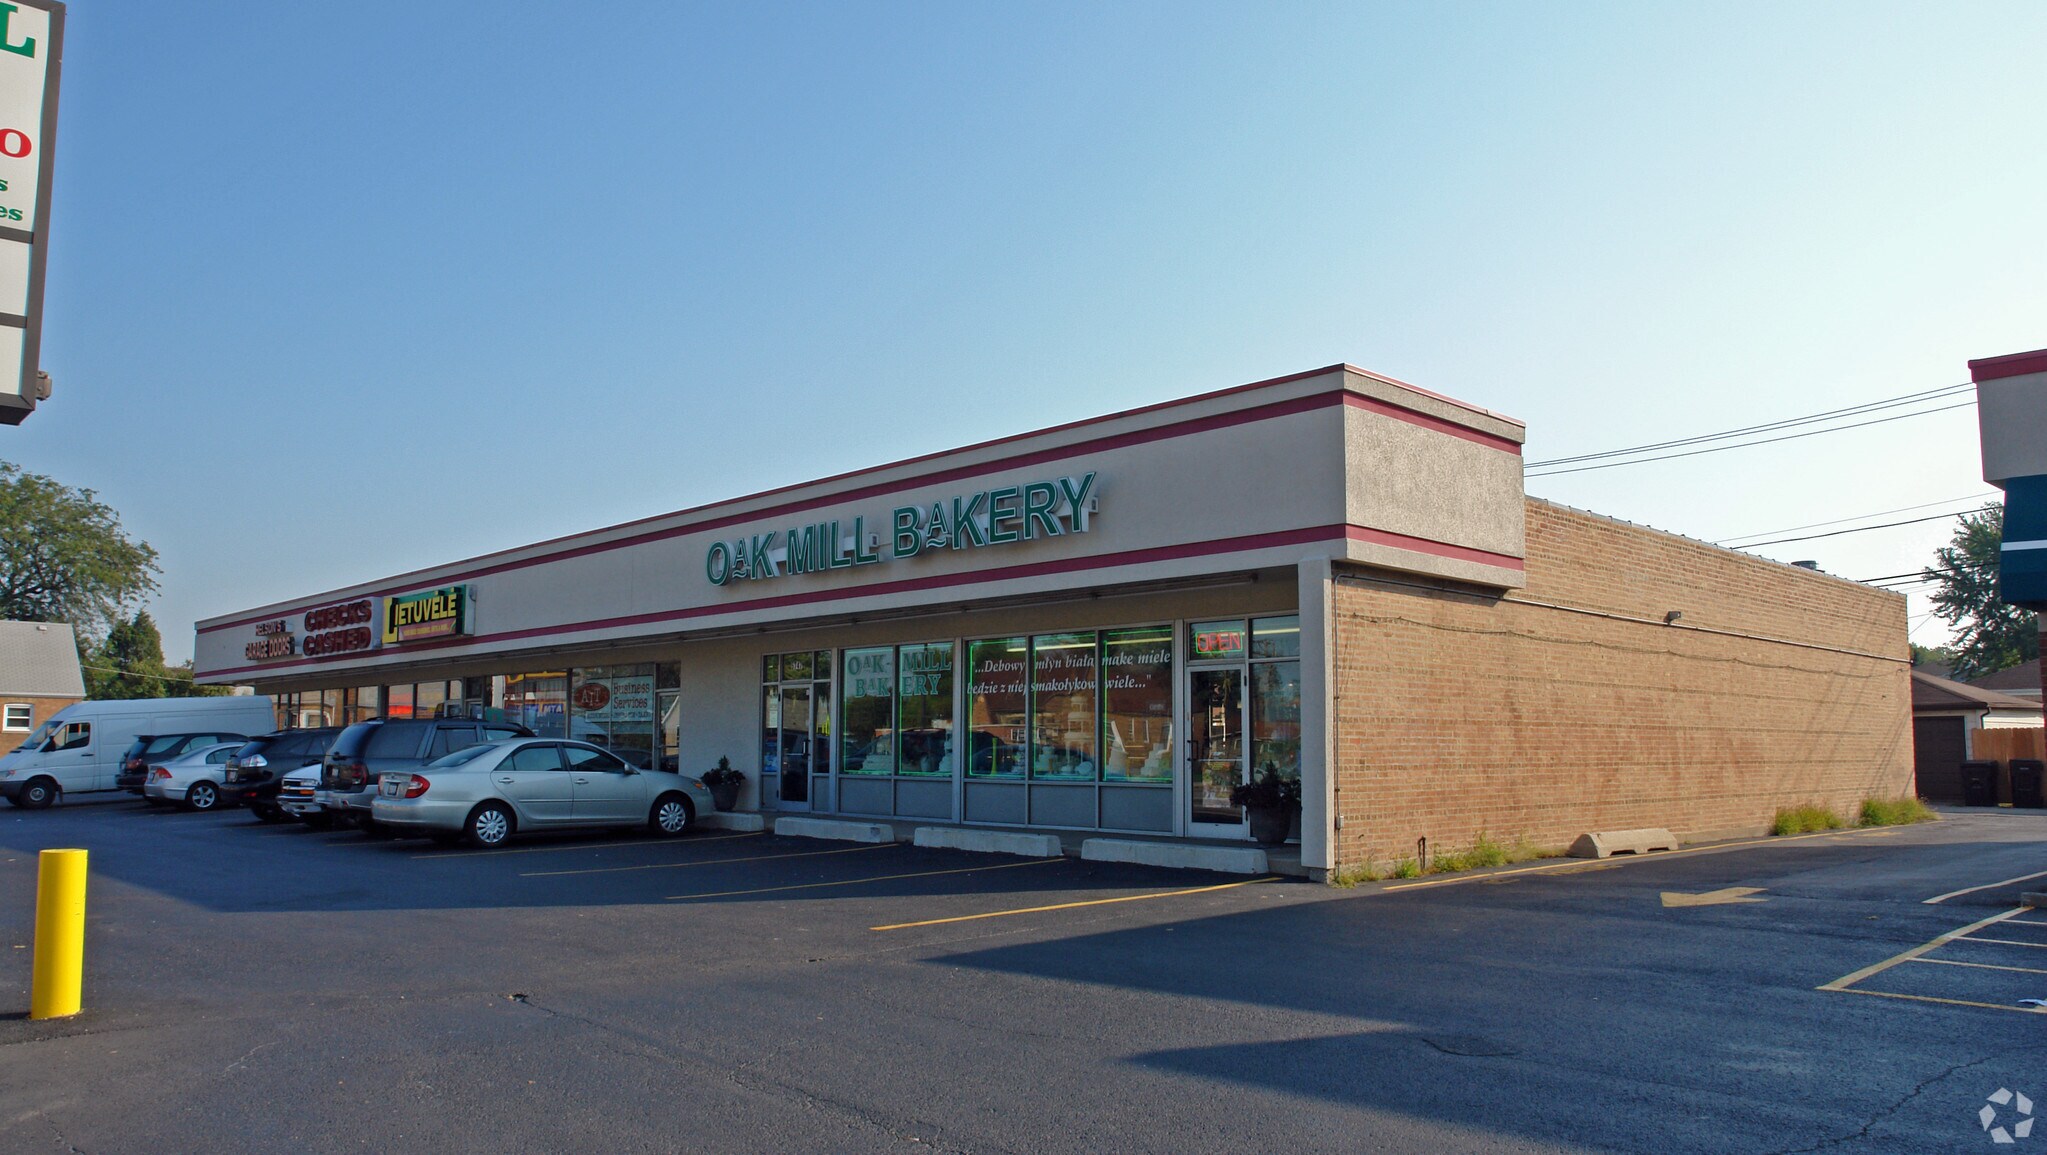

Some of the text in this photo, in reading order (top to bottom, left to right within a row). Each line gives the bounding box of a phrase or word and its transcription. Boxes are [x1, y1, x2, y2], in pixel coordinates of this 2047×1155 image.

[706, 471, 1097, 587] OAK MILL BAKERY
[304, 600, 371, 632] CHECKS
[268, 636, 290, 657] DOORS
[303, 627, 371, 656] CASHED
[1197, 632, 1241, 651] OPEN
[902, 650, 952, 672] MILL
[1138, 649, 1171, 664] miele
[613, 683, 650, 695] Business
[1000, 684, 1006, 693] z
[613, 696, 648, 709] Services
